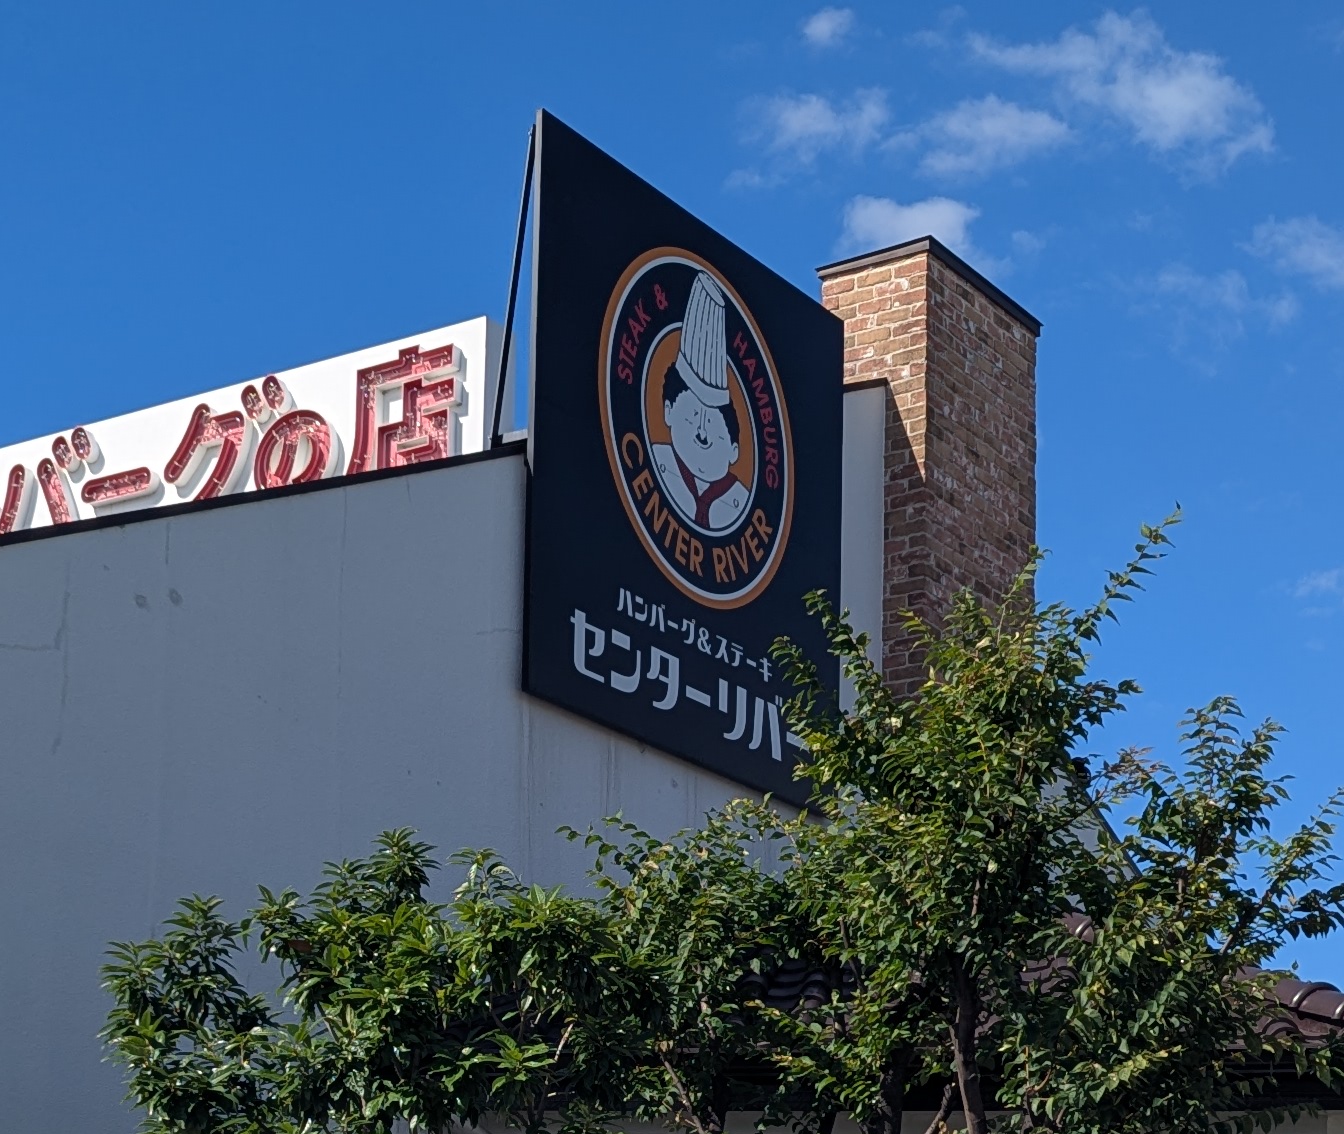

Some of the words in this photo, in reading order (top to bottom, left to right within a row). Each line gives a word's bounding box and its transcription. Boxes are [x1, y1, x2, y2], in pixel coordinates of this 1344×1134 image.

[617, 298, 653, 385] STEAK
[653, 284, 670, 311] &
[733, 331, 779, 490] HAMBURG
[621, 432, 704, 577] CENTER
[712, 508, 773, 583] RIVER
[569, 608, 809, 762] センターリバー
[617, 587, 773, 682] ハンバーグ&ステーキ
